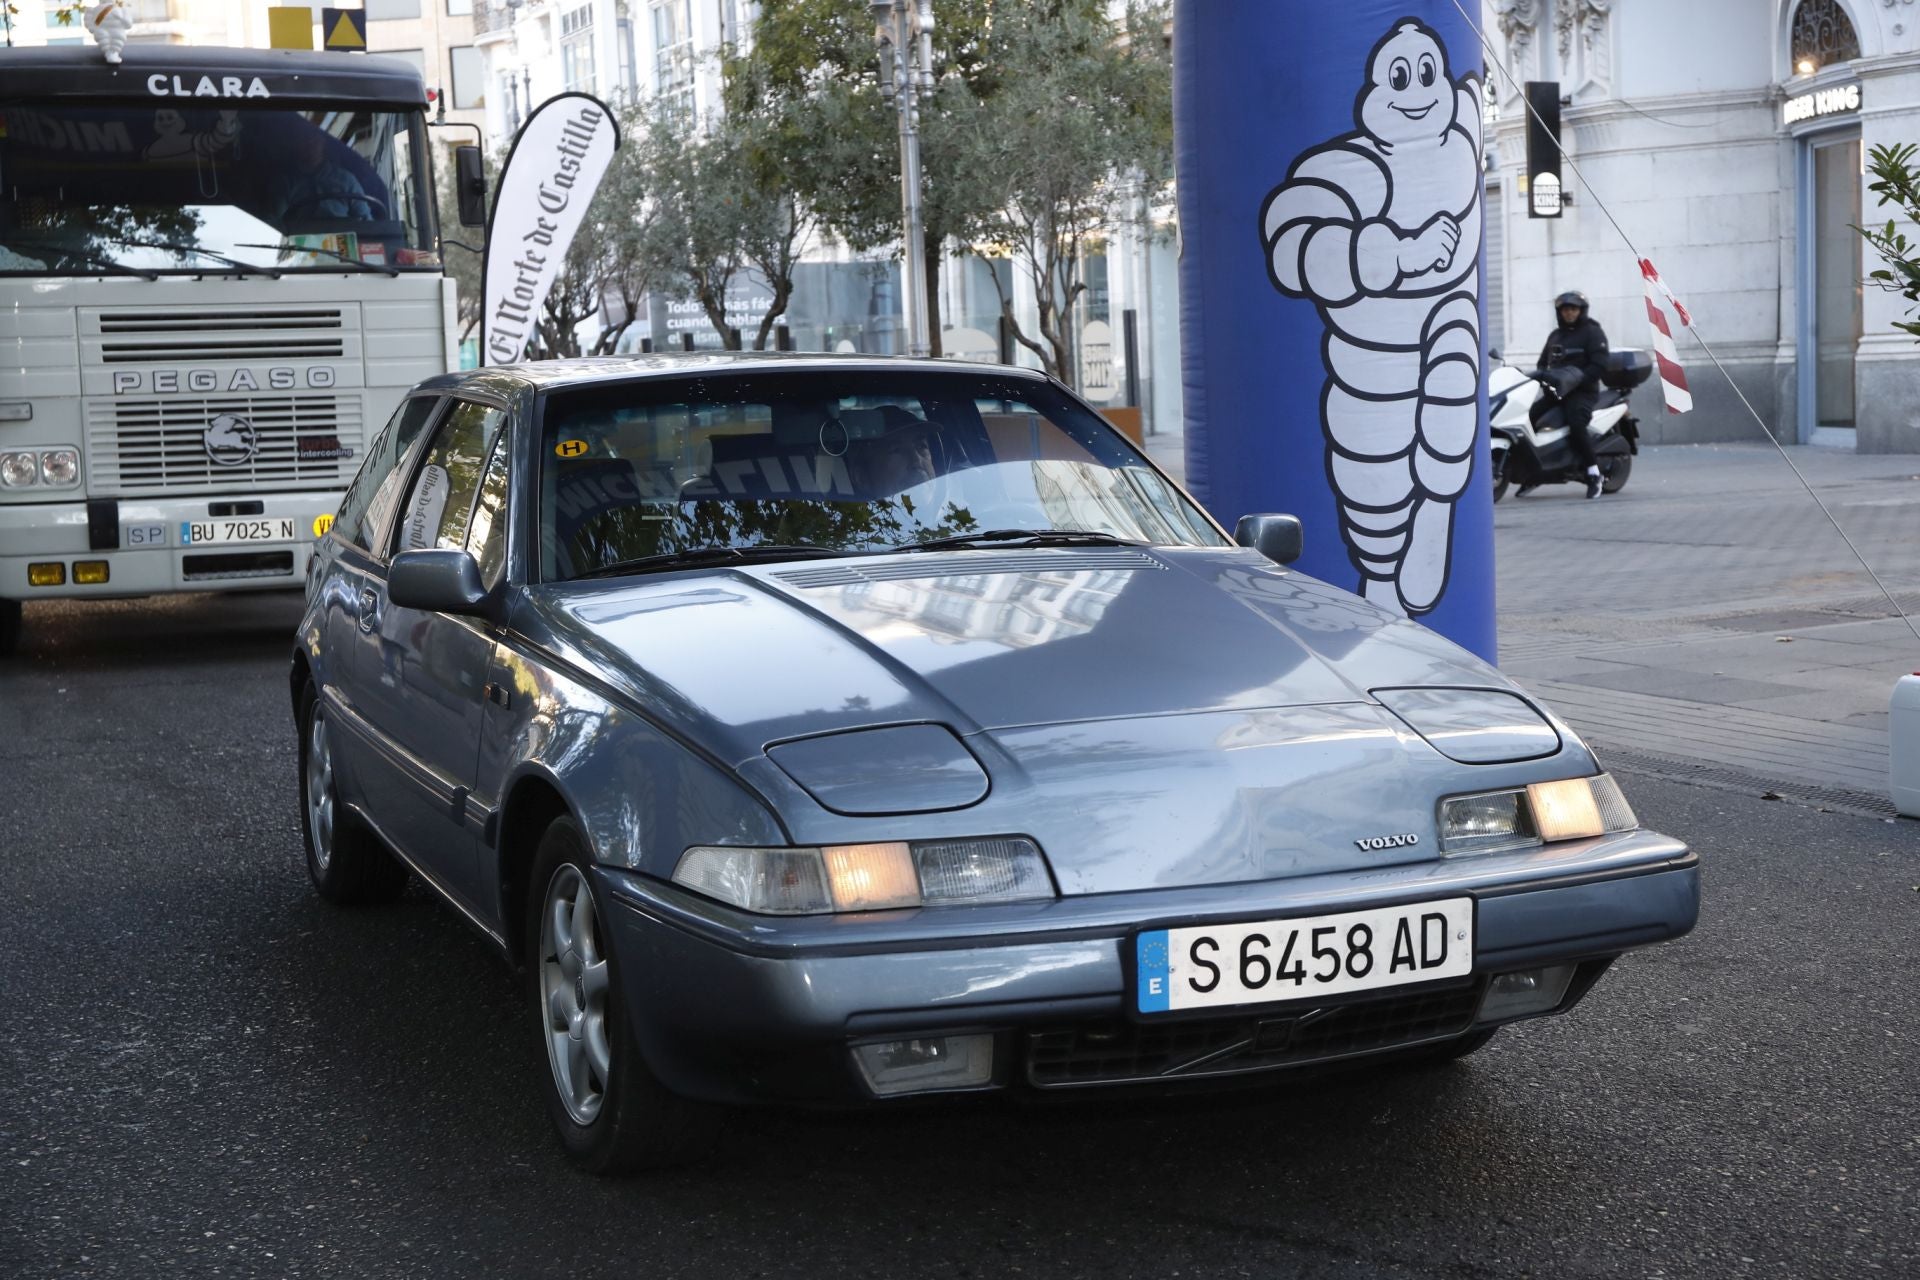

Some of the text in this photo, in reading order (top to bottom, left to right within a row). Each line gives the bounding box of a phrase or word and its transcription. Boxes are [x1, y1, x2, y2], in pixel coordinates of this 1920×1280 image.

[147, 74, 271, 98] CLARA
[1815, 85, 1859, 115] KING
[1534, 194, 1561, 207] KING
[488, 107, 603, 366] El Norte de Castilla
[666, 300, 699, 313] Todo
[724, 313, 787, 327] ablas
[113, 366, 336, 395] PEGASO
[300, 448, 353, 458] intercooling
[562, 442, 581, 455] H
[191, 520, 293, 541] BU 7025 N
[1356, 833, 1419, 851] VOLVO
[1188, 912, 1448, 993] S 6458 AD
[1150, 978, 1162, 994] E
